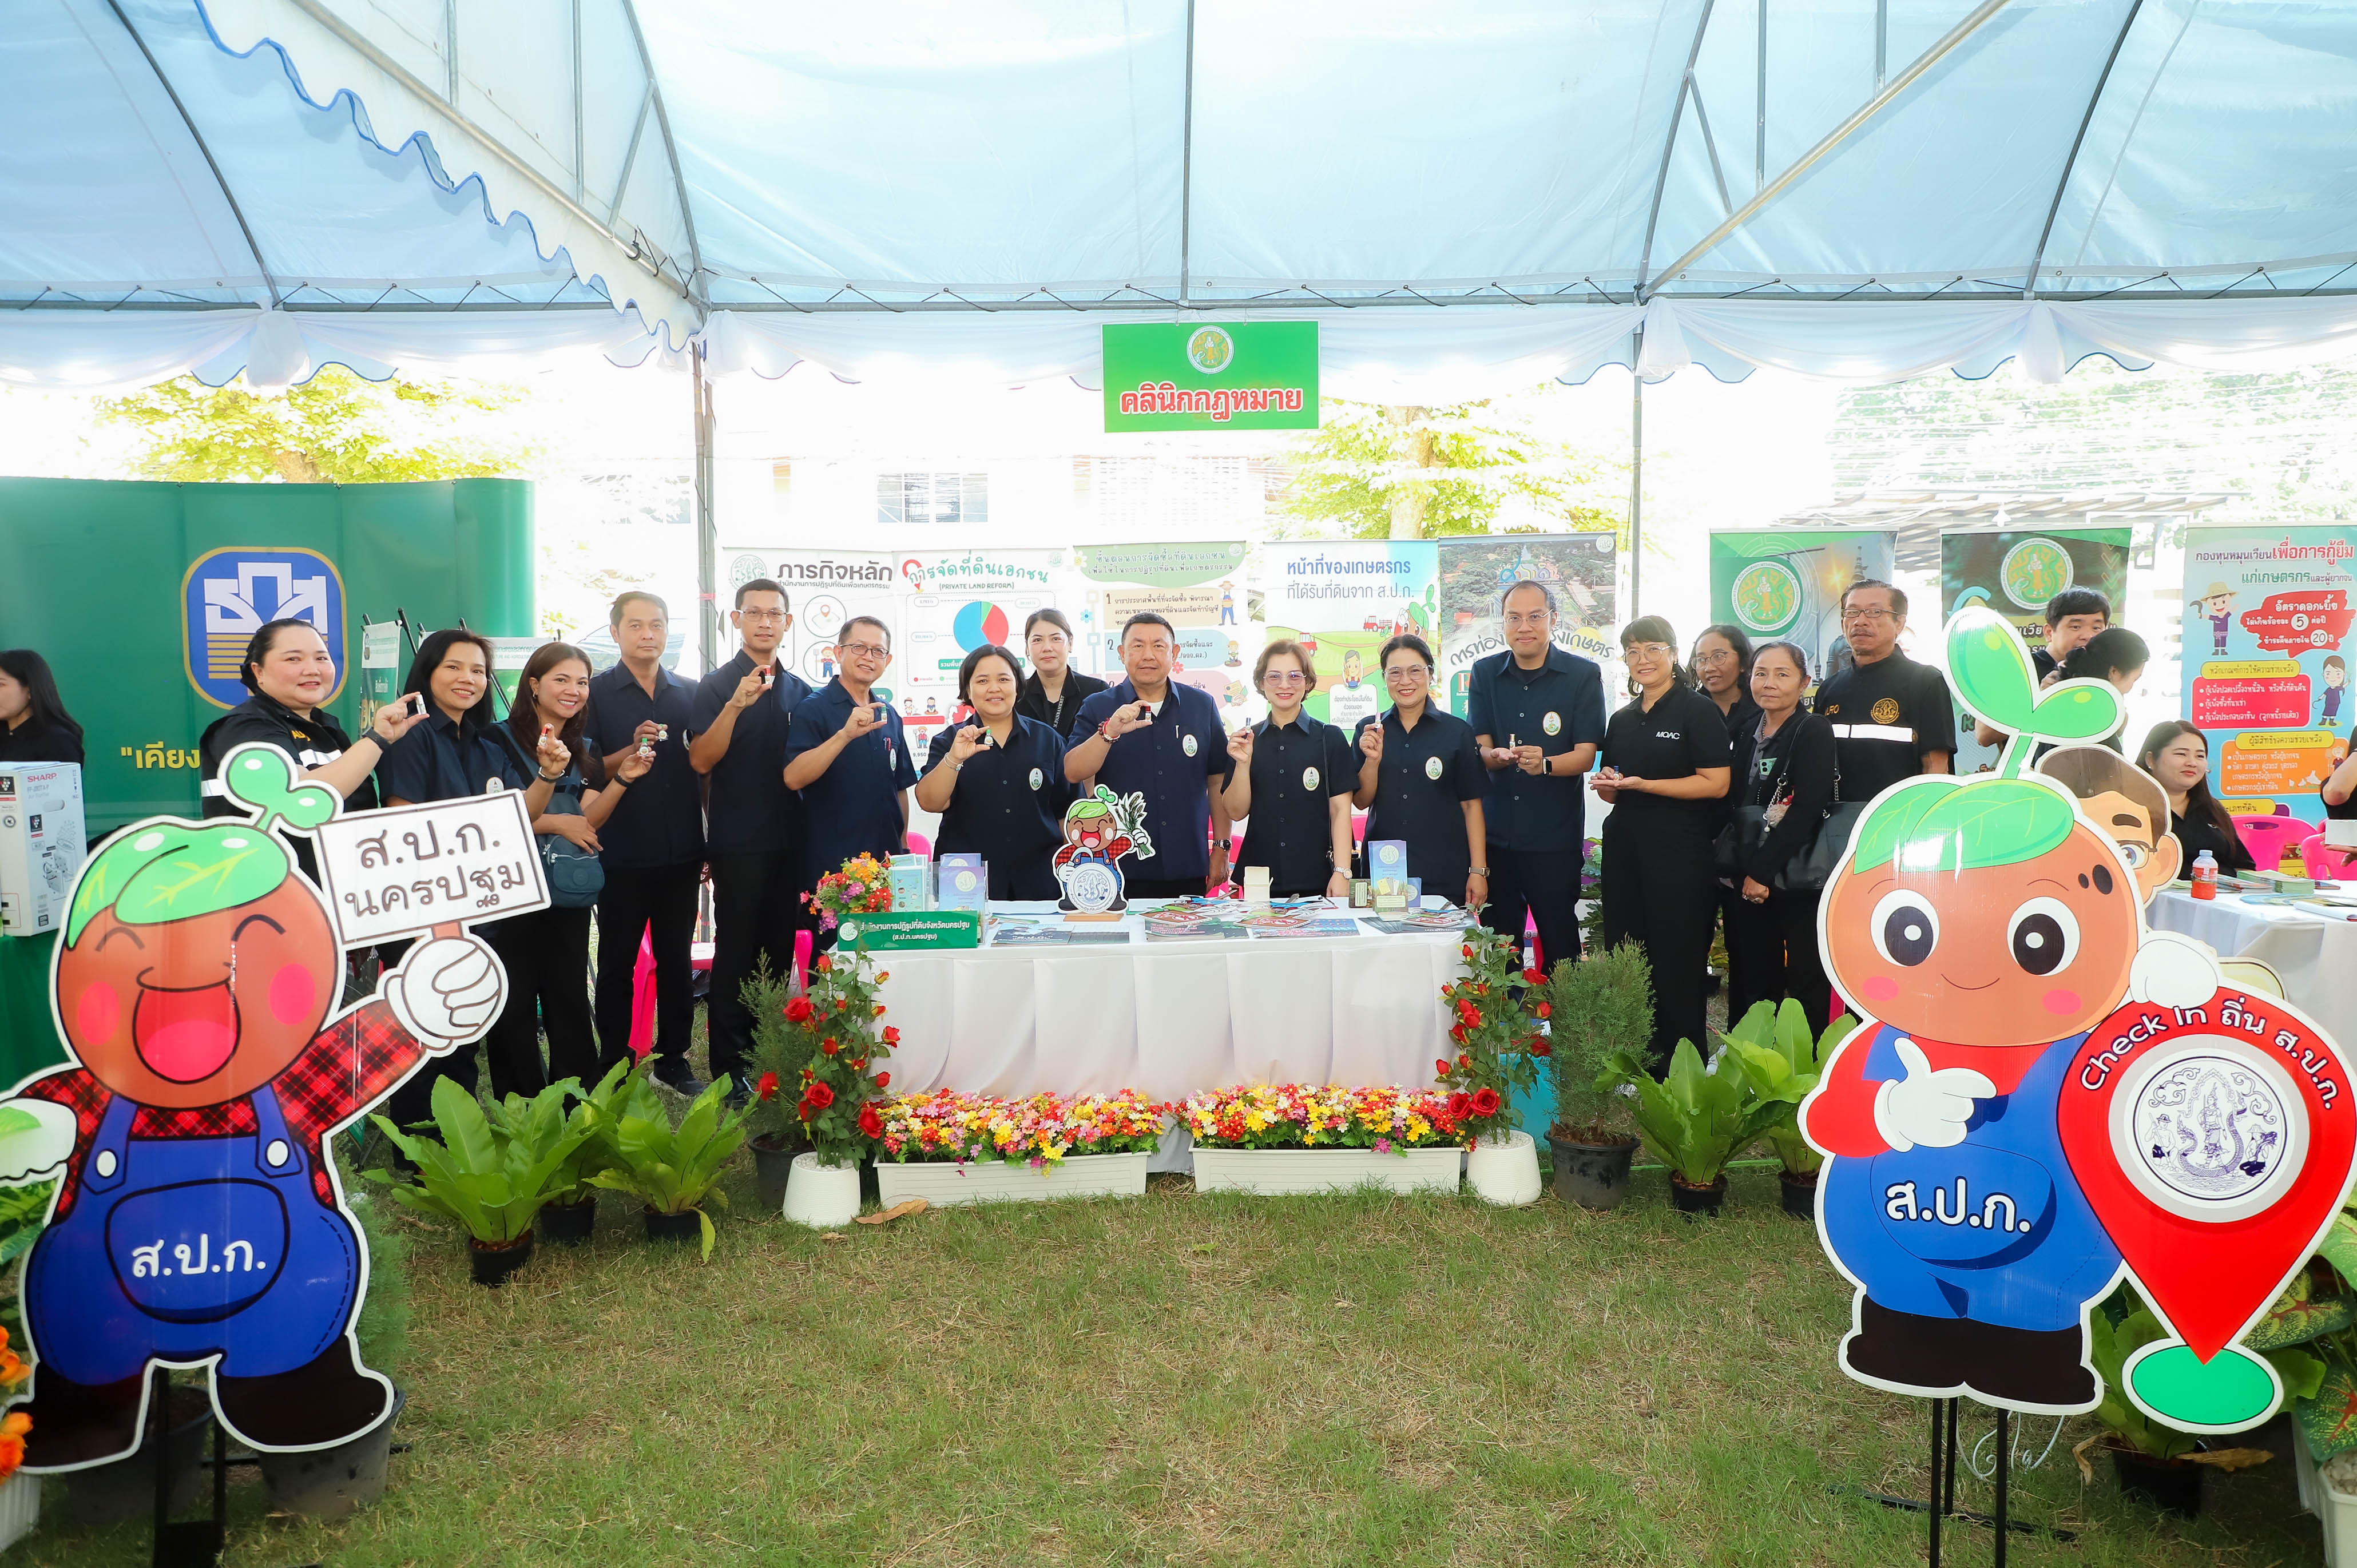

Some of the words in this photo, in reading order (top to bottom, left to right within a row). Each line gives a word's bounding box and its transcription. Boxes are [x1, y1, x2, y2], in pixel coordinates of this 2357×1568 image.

[1121, 382, 1303, 422] คลินิกกฎหมาย
[777, 561, 893, 581] ภารกิจหลัก
[908, 550, 1048, 583] การจัดที่ดินเอกชน
[1287, 553, 1411, 574] หน้าที่ของเกษตรกร
[939, 582, 967, 591] (PRIVATE
[1287, 579, 1373, 599] ที่ได้รับที่ดินจาก
[1378, 582, 1414, 598] ส.ป.ก.
[1106, 593, 1112, 604] 1
[2275, 594, 2338, 612] อัตราดอกเบี้ย
[2296, 616, 2304, 628] 5
[1108, 639, 1114, 650] 2
[2312, 633, 2326, 643] 20
[1656, 731, 1680, 739] MOAC
[27, 773, 57, 783] SHARP
[356, 820, 501, 869] ส.ป.ก.
[344, 861, 526, 917] นครปฐม
[2081, 1014, 2169, 1091] Check
[2173, 1006, 2208, 1026] In
[2220, 995, 2267, 1035] ถิ่น
[2274, 1028, 2339, 1110] ส.ป.ก.
[1886, 1177, 2031, 1233] ส.ป.ก.
[132, 1233, 267, 1278] ส.ป.ก.
